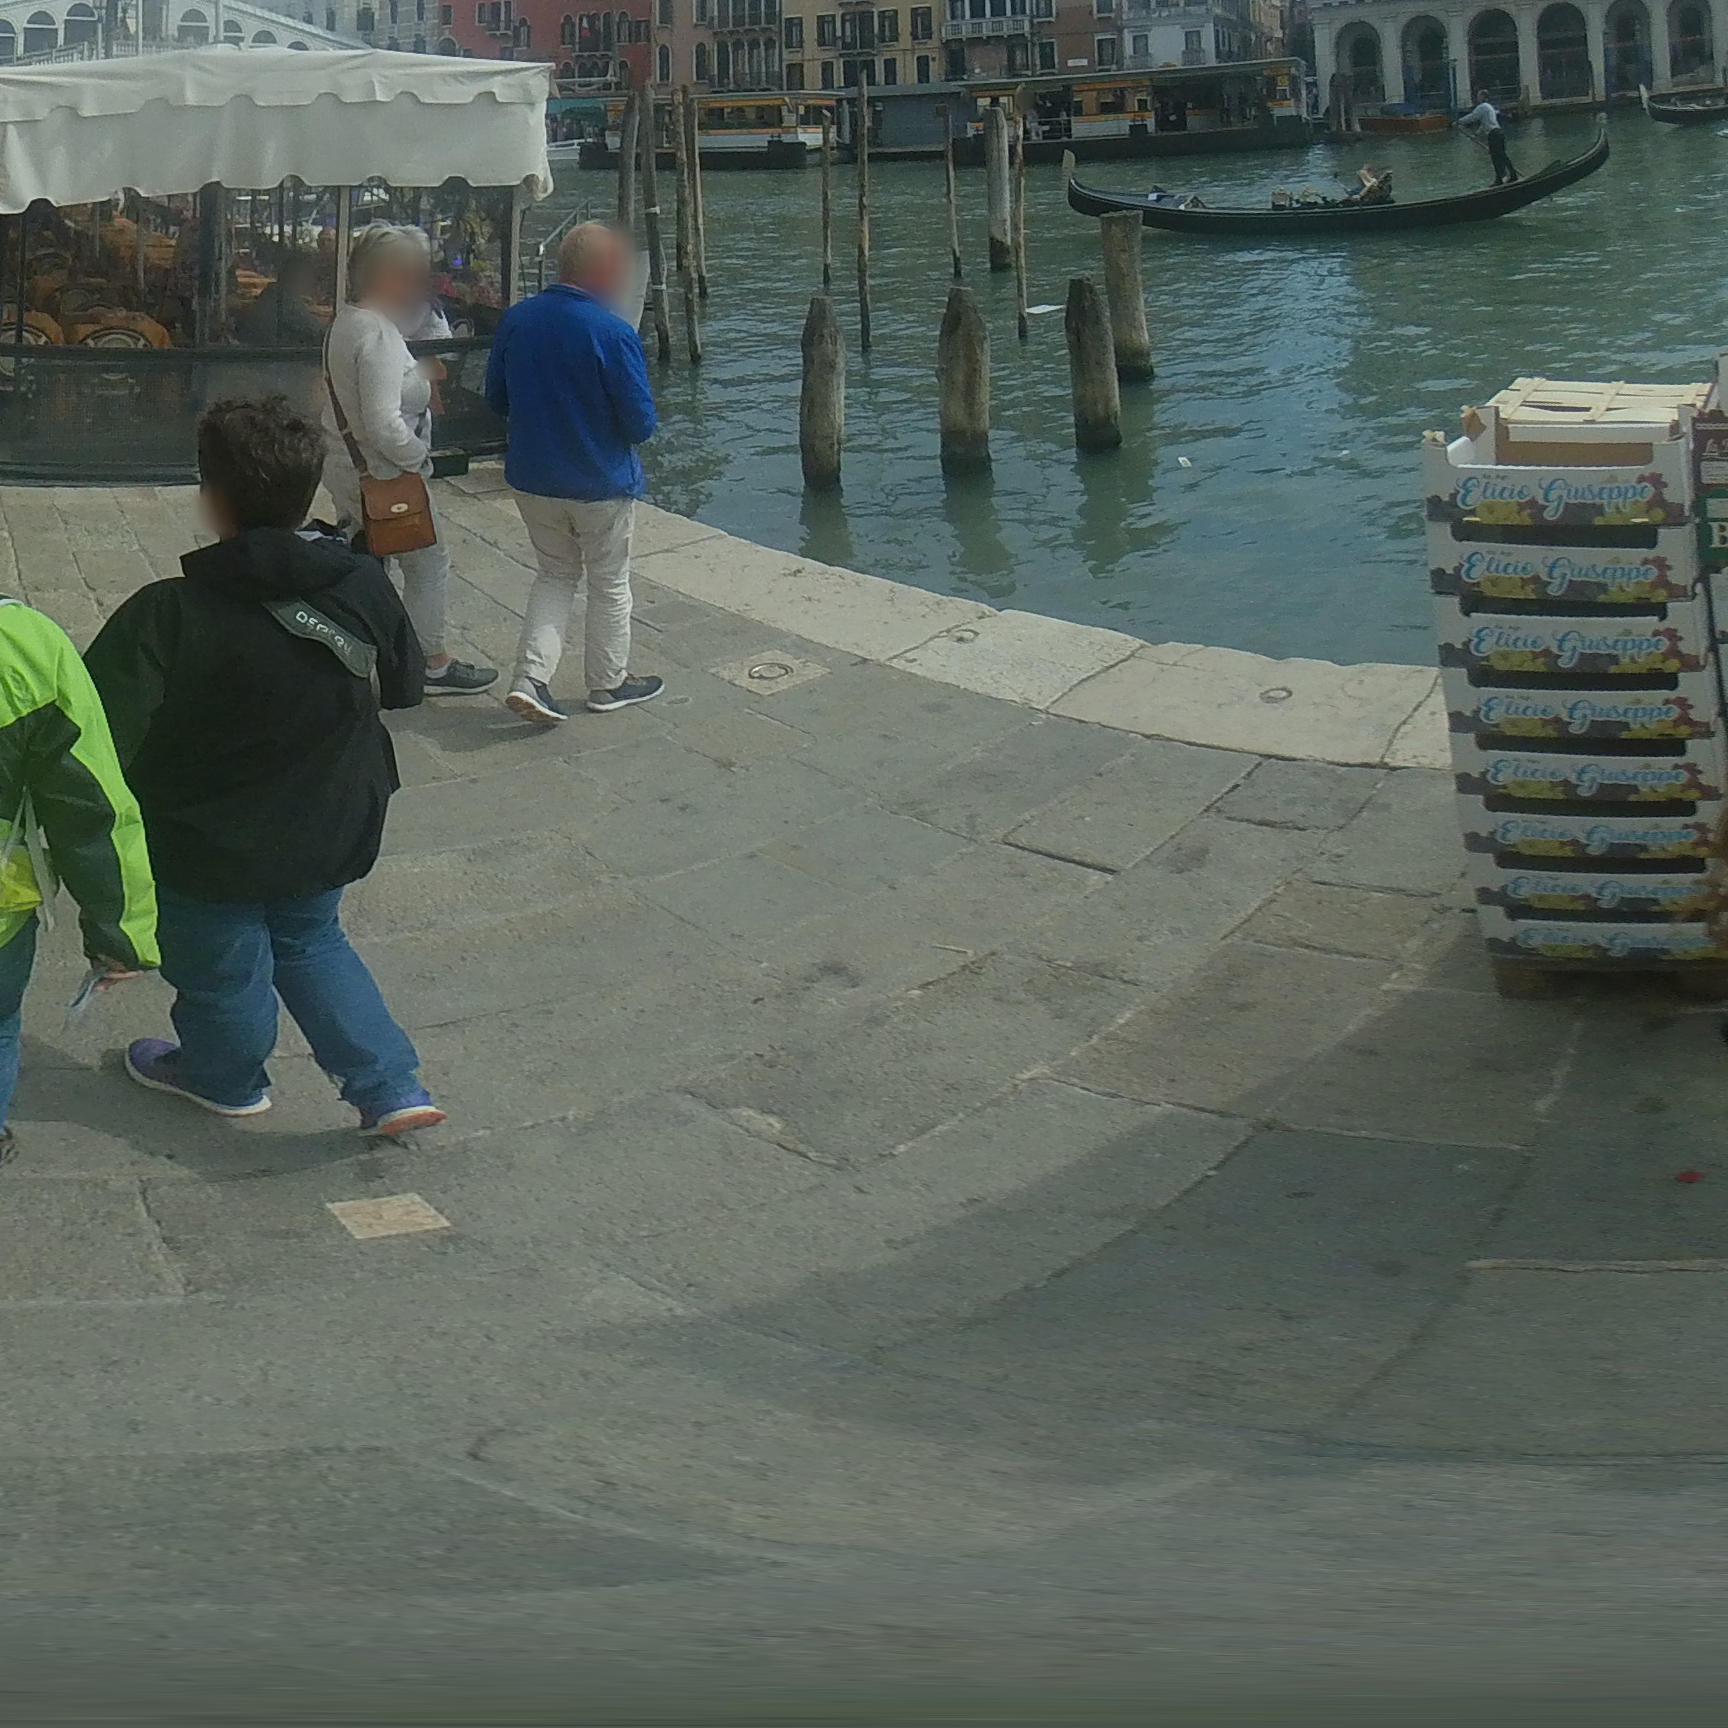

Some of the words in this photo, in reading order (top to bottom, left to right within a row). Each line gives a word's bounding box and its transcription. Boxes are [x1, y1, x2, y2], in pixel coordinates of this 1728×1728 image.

[1456, 476, 1531, 509] Elicio
[1539, 478, 1653, 520] Giuseppe
[1461, 552, 1537, 582] Elicio
[1543, 557, 1658, 596] Giuseppe
[1470, 626, 1544, 656] Elicio
[1552, 630, 1668, 668] Giuseppe
[1479, 696, 1555, 723] Elicio
